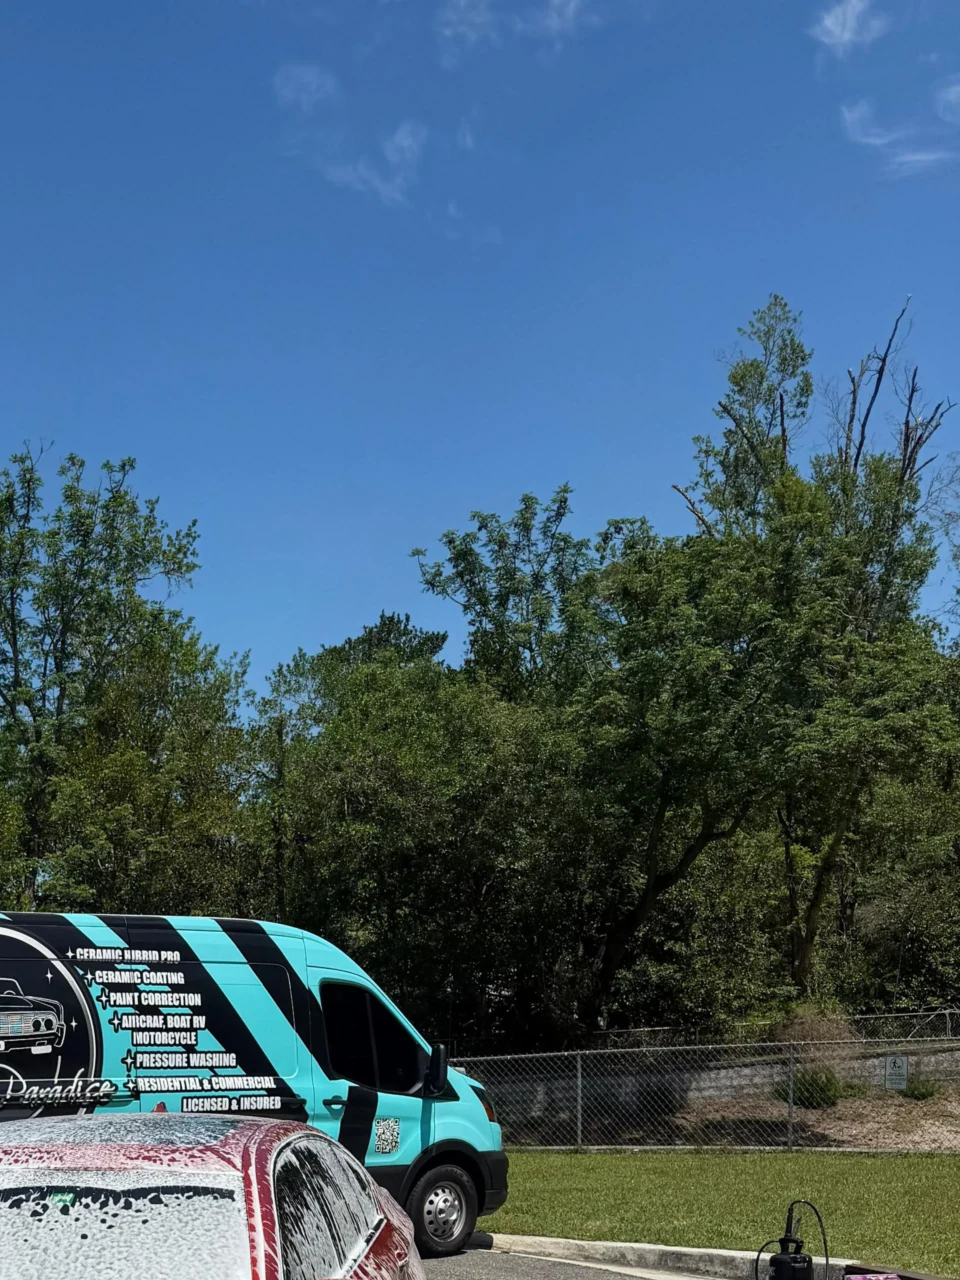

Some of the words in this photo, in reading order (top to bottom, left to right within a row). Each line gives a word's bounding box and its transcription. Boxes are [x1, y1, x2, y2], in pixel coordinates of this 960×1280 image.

[76, 948, 122, 962] CERAMIC
[161, 951, 180, 964] PRO
[95, 970, 141, 984] CERAMIC
[142, 971, 185, 985] COATING
[109, 992, 139, 1006] PAINT
[141, 992, 202, 1006] CORRECTION
[167, 1015, 191, 1028] BOAT
[192, 1015, 206, 1029] RV
[133, 1031, 197, 1045] MOTORCYCLE
[136, 1053, 188, 1068] PRESSURE
[189, 1053, 236, 1067] WASHING
[137, 1077, 202, 1092] RESIDENTIAL
[203, 1078, 211, 1090] &
[211, 1076, 276, 1090] COMMERCIAL
[182, 1098, 229, 1112] LICENSED
[230, 1098, 238, 1111] &
[240, 1096, 281, 1110] INSURED
